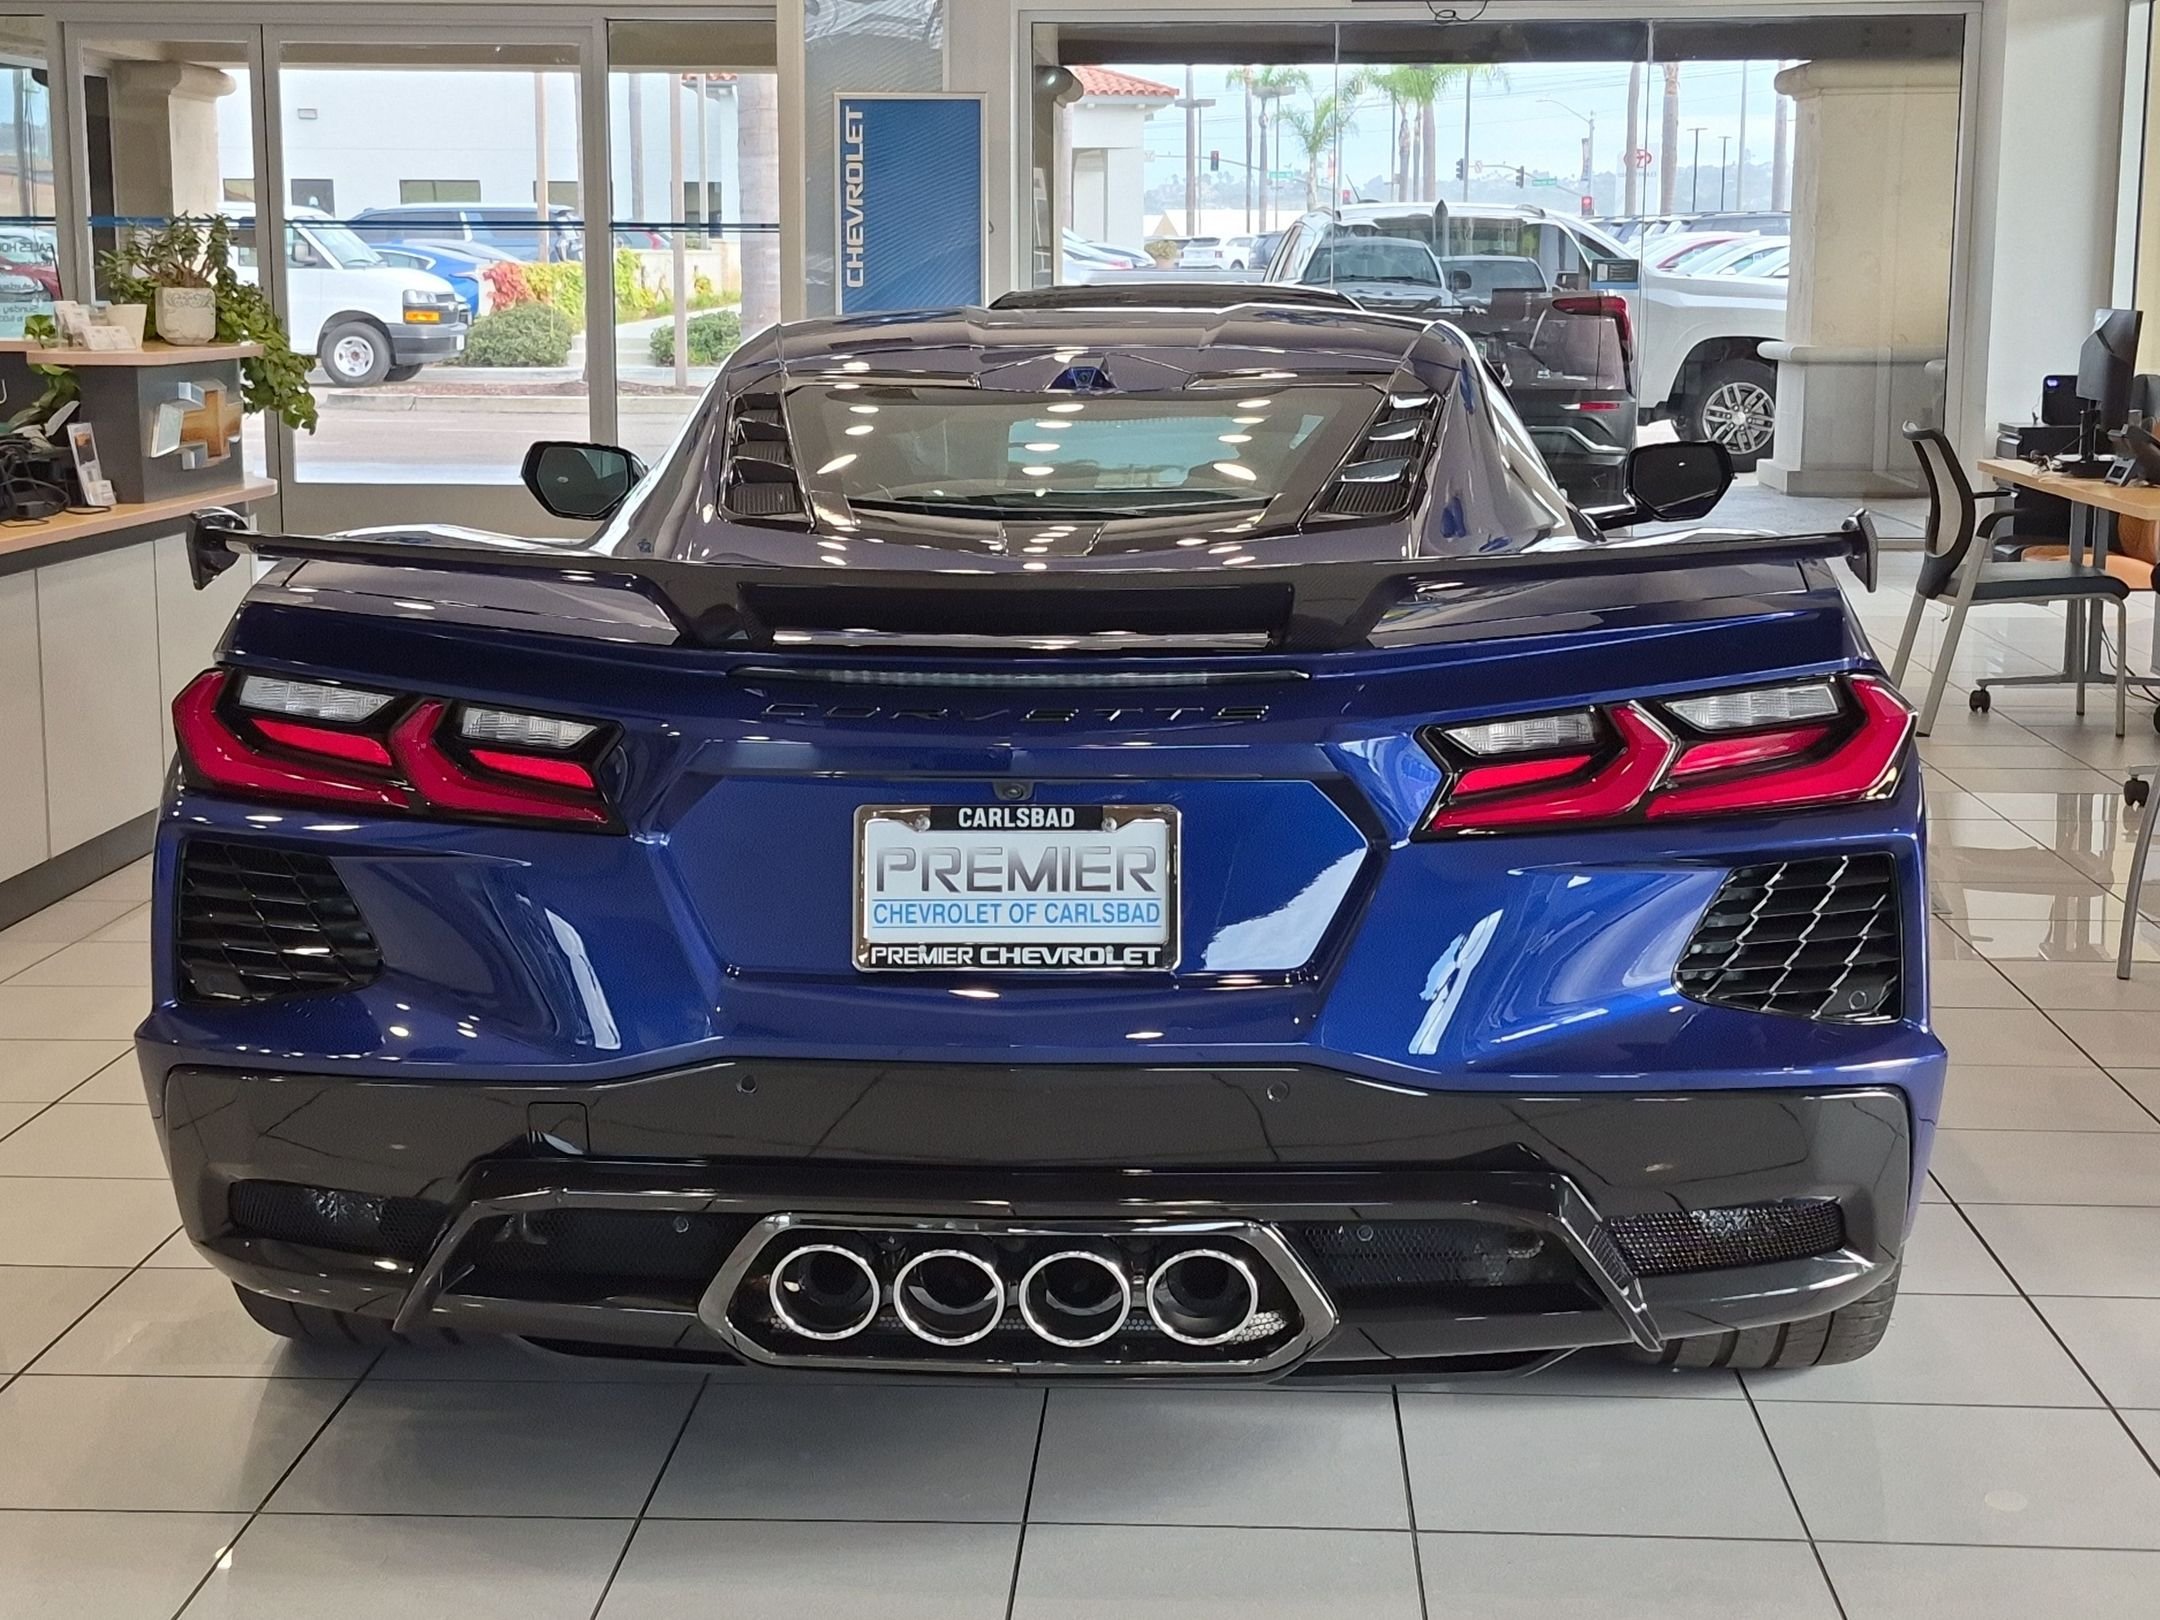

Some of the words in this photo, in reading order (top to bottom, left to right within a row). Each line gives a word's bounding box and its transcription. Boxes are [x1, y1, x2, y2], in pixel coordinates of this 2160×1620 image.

[845, 105, 864, 288] CHEVROLET
[761, 703, 1271, 722] CORVETTE
[958, 807, 1075, 828] CARLSBAD
[875, 846, 1157, 893] PREMIER
[873, 902, 1001, 924] CHEVROLET
[1008, 902, 1037, 924] OF
[1044, 902, 1161, 924] CARLSBAD
[870, 946, 974, 965] PREMIER
[979, 946, 1161, 965] CHEVROLET
